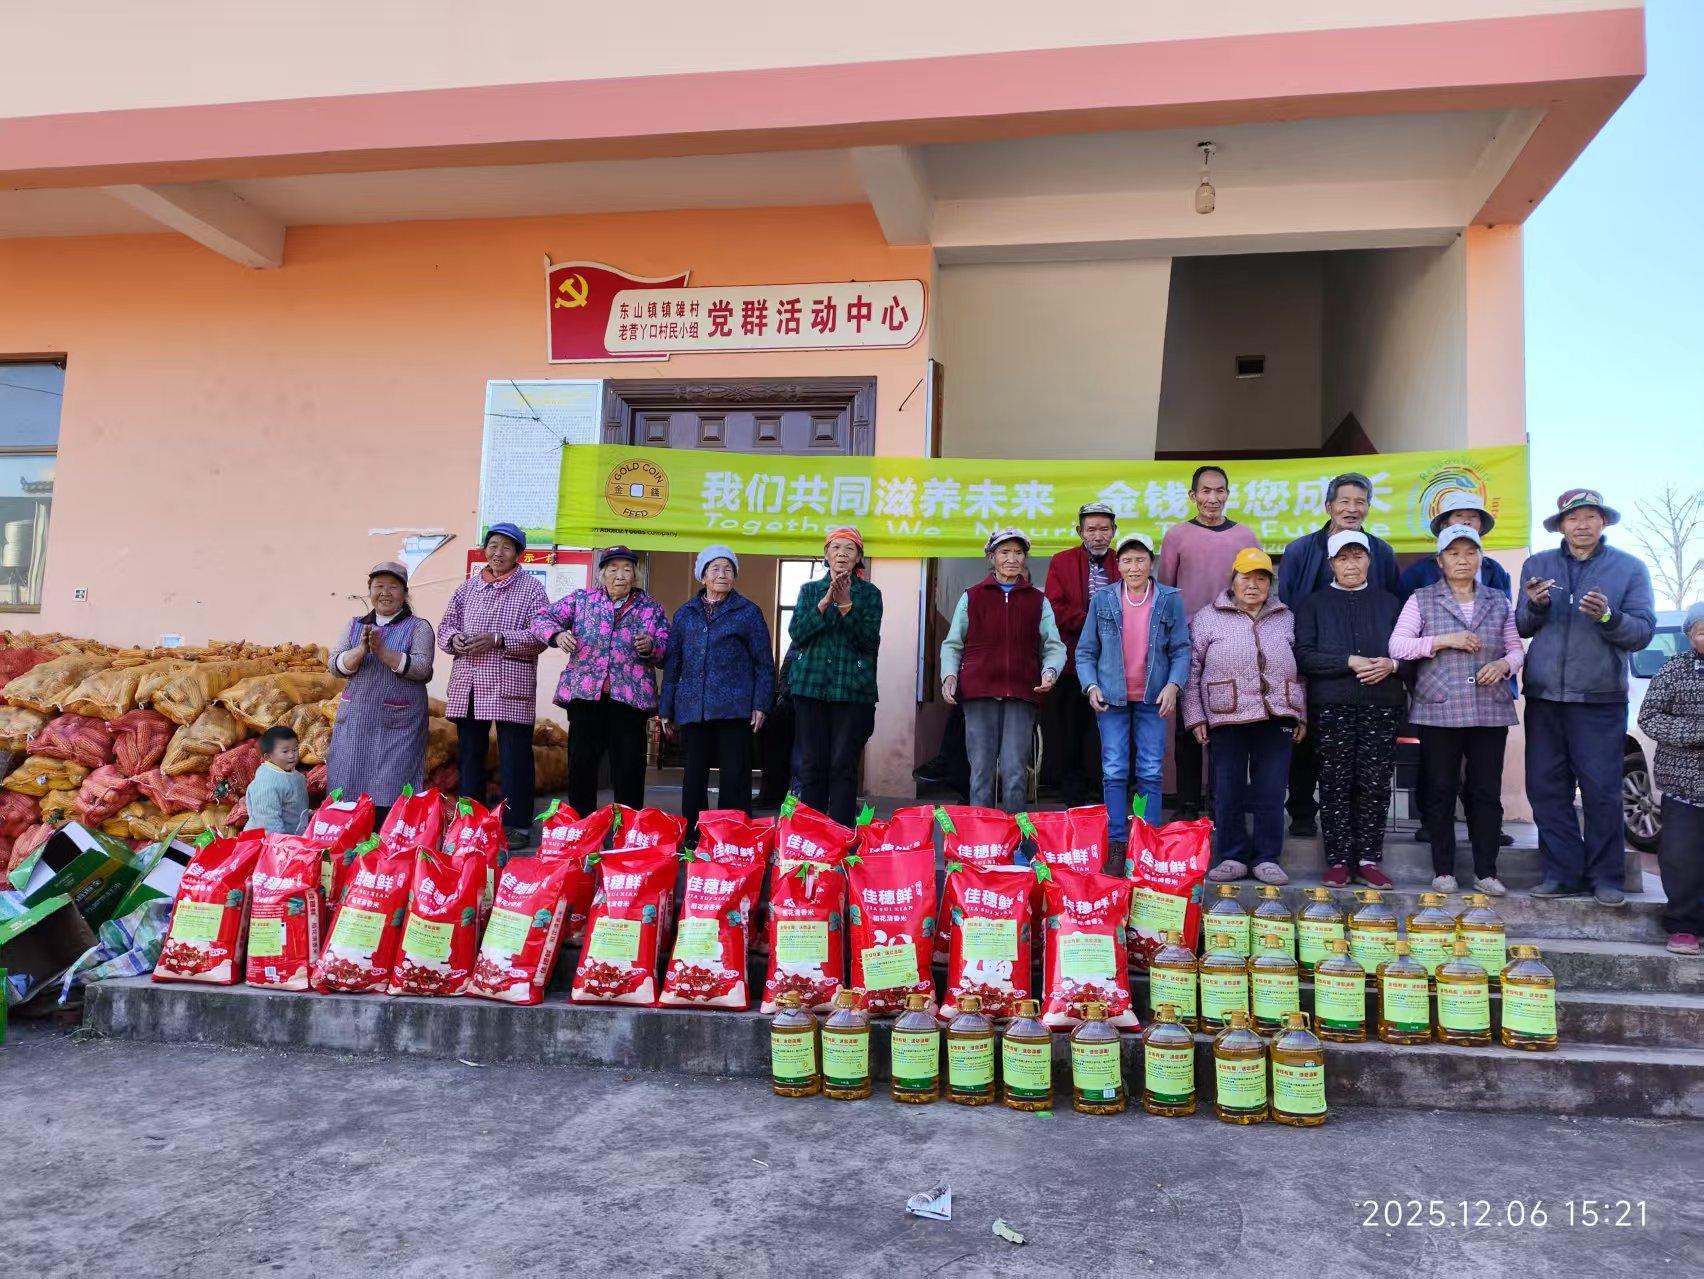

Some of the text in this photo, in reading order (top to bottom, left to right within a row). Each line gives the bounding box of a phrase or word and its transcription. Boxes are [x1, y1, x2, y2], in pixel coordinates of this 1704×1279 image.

[620, 300, 699, 319] 东山镇镇雄村
[707, 294, 909, 337] 党群活动中心
[618, 321, 699, 340] 老营丫口村民小组
[614, 462, 664, 484] GOLD COIN
[702, 471, 1056, 519] 我们共同滋养未来
[886, 520, 942, 536] We
[688, 876, 736, 894] 佳穗鲜
[862, 888, 913, 905] 佳穗鲜
[964, 888, 1014, 909] 佳穗鲜
